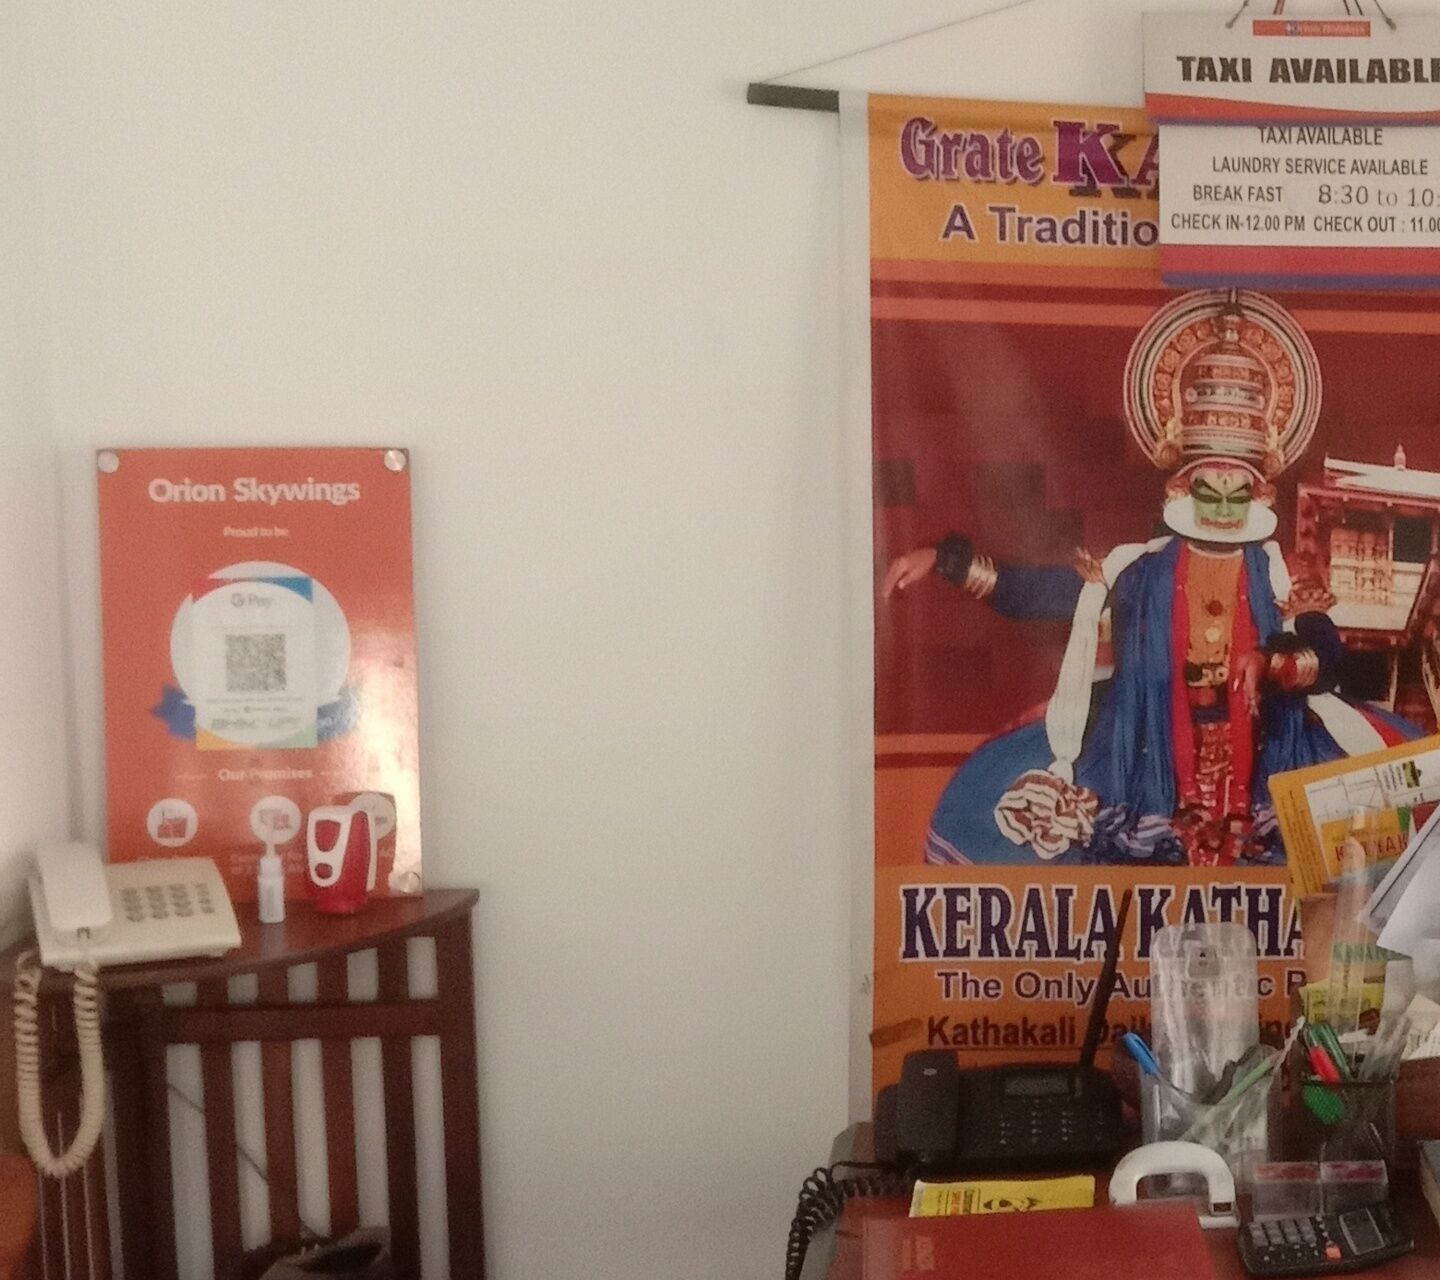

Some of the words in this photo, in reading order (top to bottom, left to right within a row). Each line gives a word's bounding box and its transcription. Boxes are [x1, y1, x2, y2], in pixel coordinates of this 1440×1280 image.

[1176, 56, 1252, 82] TAXI
[1258, 127, 1293, 145] TAXI
[1296, 128, 1383, 146] AVAILABLE
[900, 117, 1044, 184] Grate
[1212, 157, 1281, 174] LAUNDRY
[1285, 158, 1347, 175] SERVICE
[1350, 159, 1429, 176] AVAILABLE
[1193, 184, 1243, 201] BREAK
[1248, 186, 1283, 202] FAST
[1317, 184, 1370, 205] 8:30
[1377, 188, 1398, 207] to
[942, 205, 975, 241] A
[1171, 213, 1222, 231] CHECK
[1284, 215, 1305, 231] PM
[1313, 216, 1364, 232] CHECK
[1368, 216, 1397, 232] OUT
[148, 479, 226, 503] Orion
[233, 477, 361, 506] Skywings
[223, 526, 257, 538] Proud
[901, 885, 1120, 960] KERALA
[937, 971, 1001, 999] The
[1014, 971, 1096, 1007] Only
[927, 1015, 1076, 1046] Kathakali
